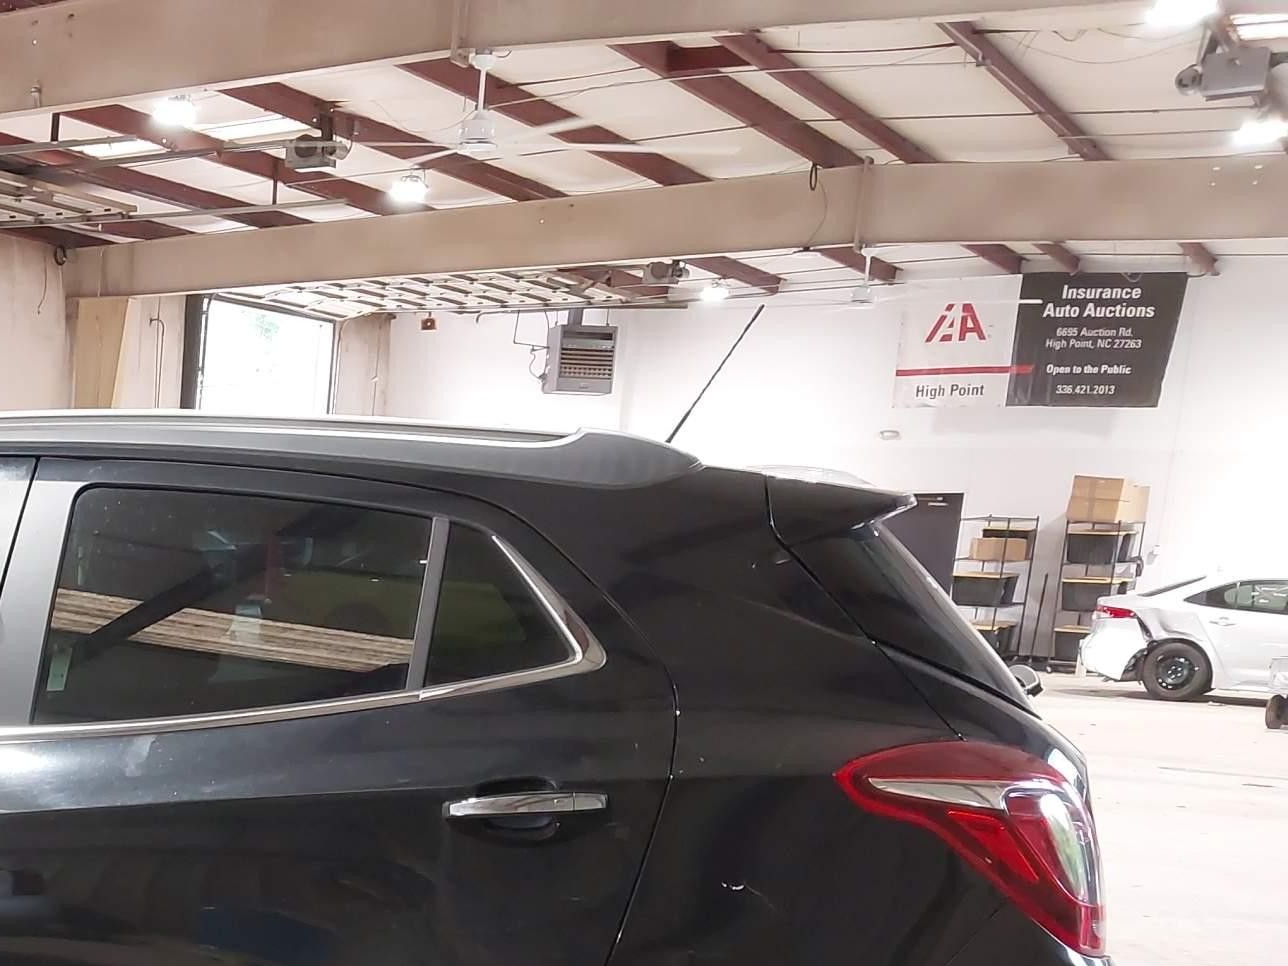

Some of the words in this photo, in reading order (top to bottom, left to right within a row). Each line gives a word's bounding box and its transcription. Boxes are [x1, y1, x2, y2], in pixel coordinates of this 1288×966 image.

[1062, 284, 1141, 299] Insurance
[1043, 302, 1080, 318] Auto
[1084, 302, 1155, 318] Auctions
[1080, 328, 1117, 337] Auction
[1119, 328, 1133, 337] Rd.
[1046, 339, 1068, 349] High
[1070, 339, 1094, 349] Point,
[1097, 340, 1112, 348] NC
[1113, 340, 1142, 348] 27263
[1046, 365, 1071, 376] Open
[1073, 366, 1082, 374] to
[1084, 365, 1098, 374] the
[1100, 365, 1132, 374] Public
[916, 384, 944, 400] High
[950, 384, 984, 396] Point
